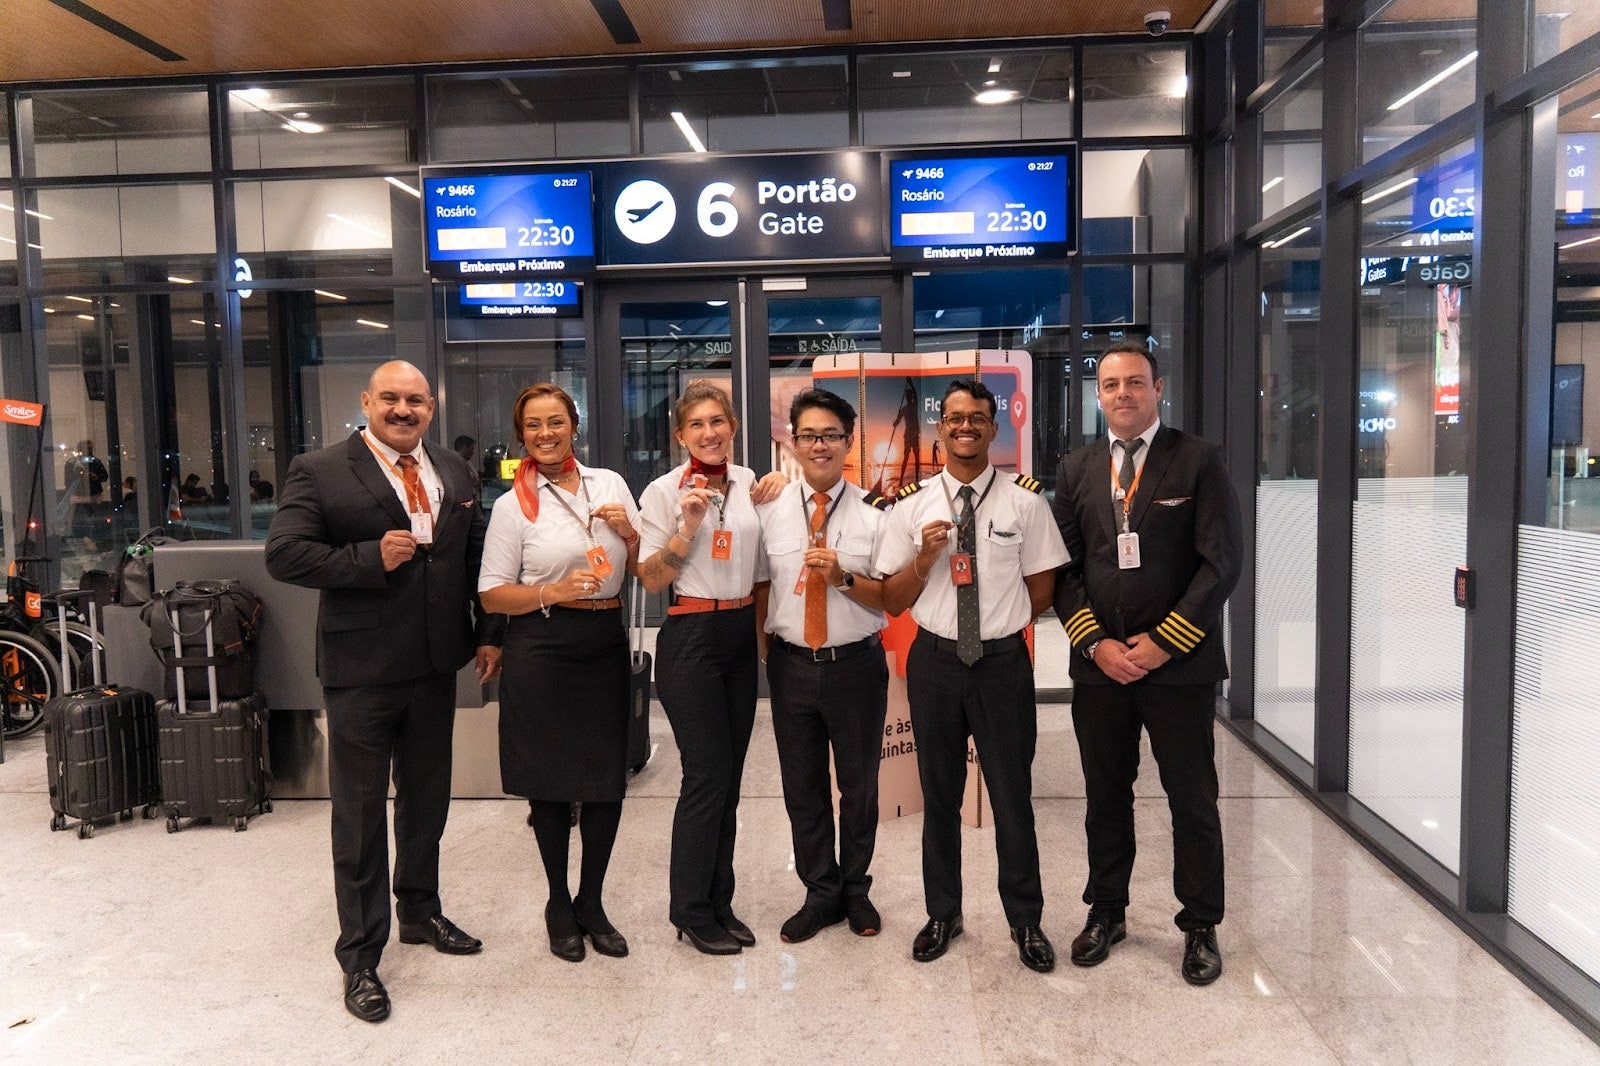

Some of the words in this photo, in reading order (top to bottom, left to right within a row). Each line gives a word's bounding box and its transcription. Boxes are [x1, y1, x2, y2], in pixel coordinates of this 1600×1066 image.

[916, 168, 944, 179] 9466
[448, 185, 476, 196] 9466
[758, 176, 857, 206] Portão
[901, 188, 944, 202] Rosário
[436, 205, 477, 218] Rosário
[696, 182, 740, 237] 6
[759, 212, 824, 236] Gate
[986, 210, 1047, 232] 22:30
[518, 226, 575, 247] 22:30
[923, 247, 983, 260] Embarque
[985, 244, 1035, 257] Próximo
[460, 261, 516, 274] Embarque
[518, 259, 565, 271] Próximo
[523, 282, 565, 298] 22:30
[481, 305, 522, 316] Embarque
[523, 305, 558, 315] Próximo
[705, 341, 732, 355] SAID
[4, 403, 37, 419] Smiles
[896, 718, 912, 734] às
